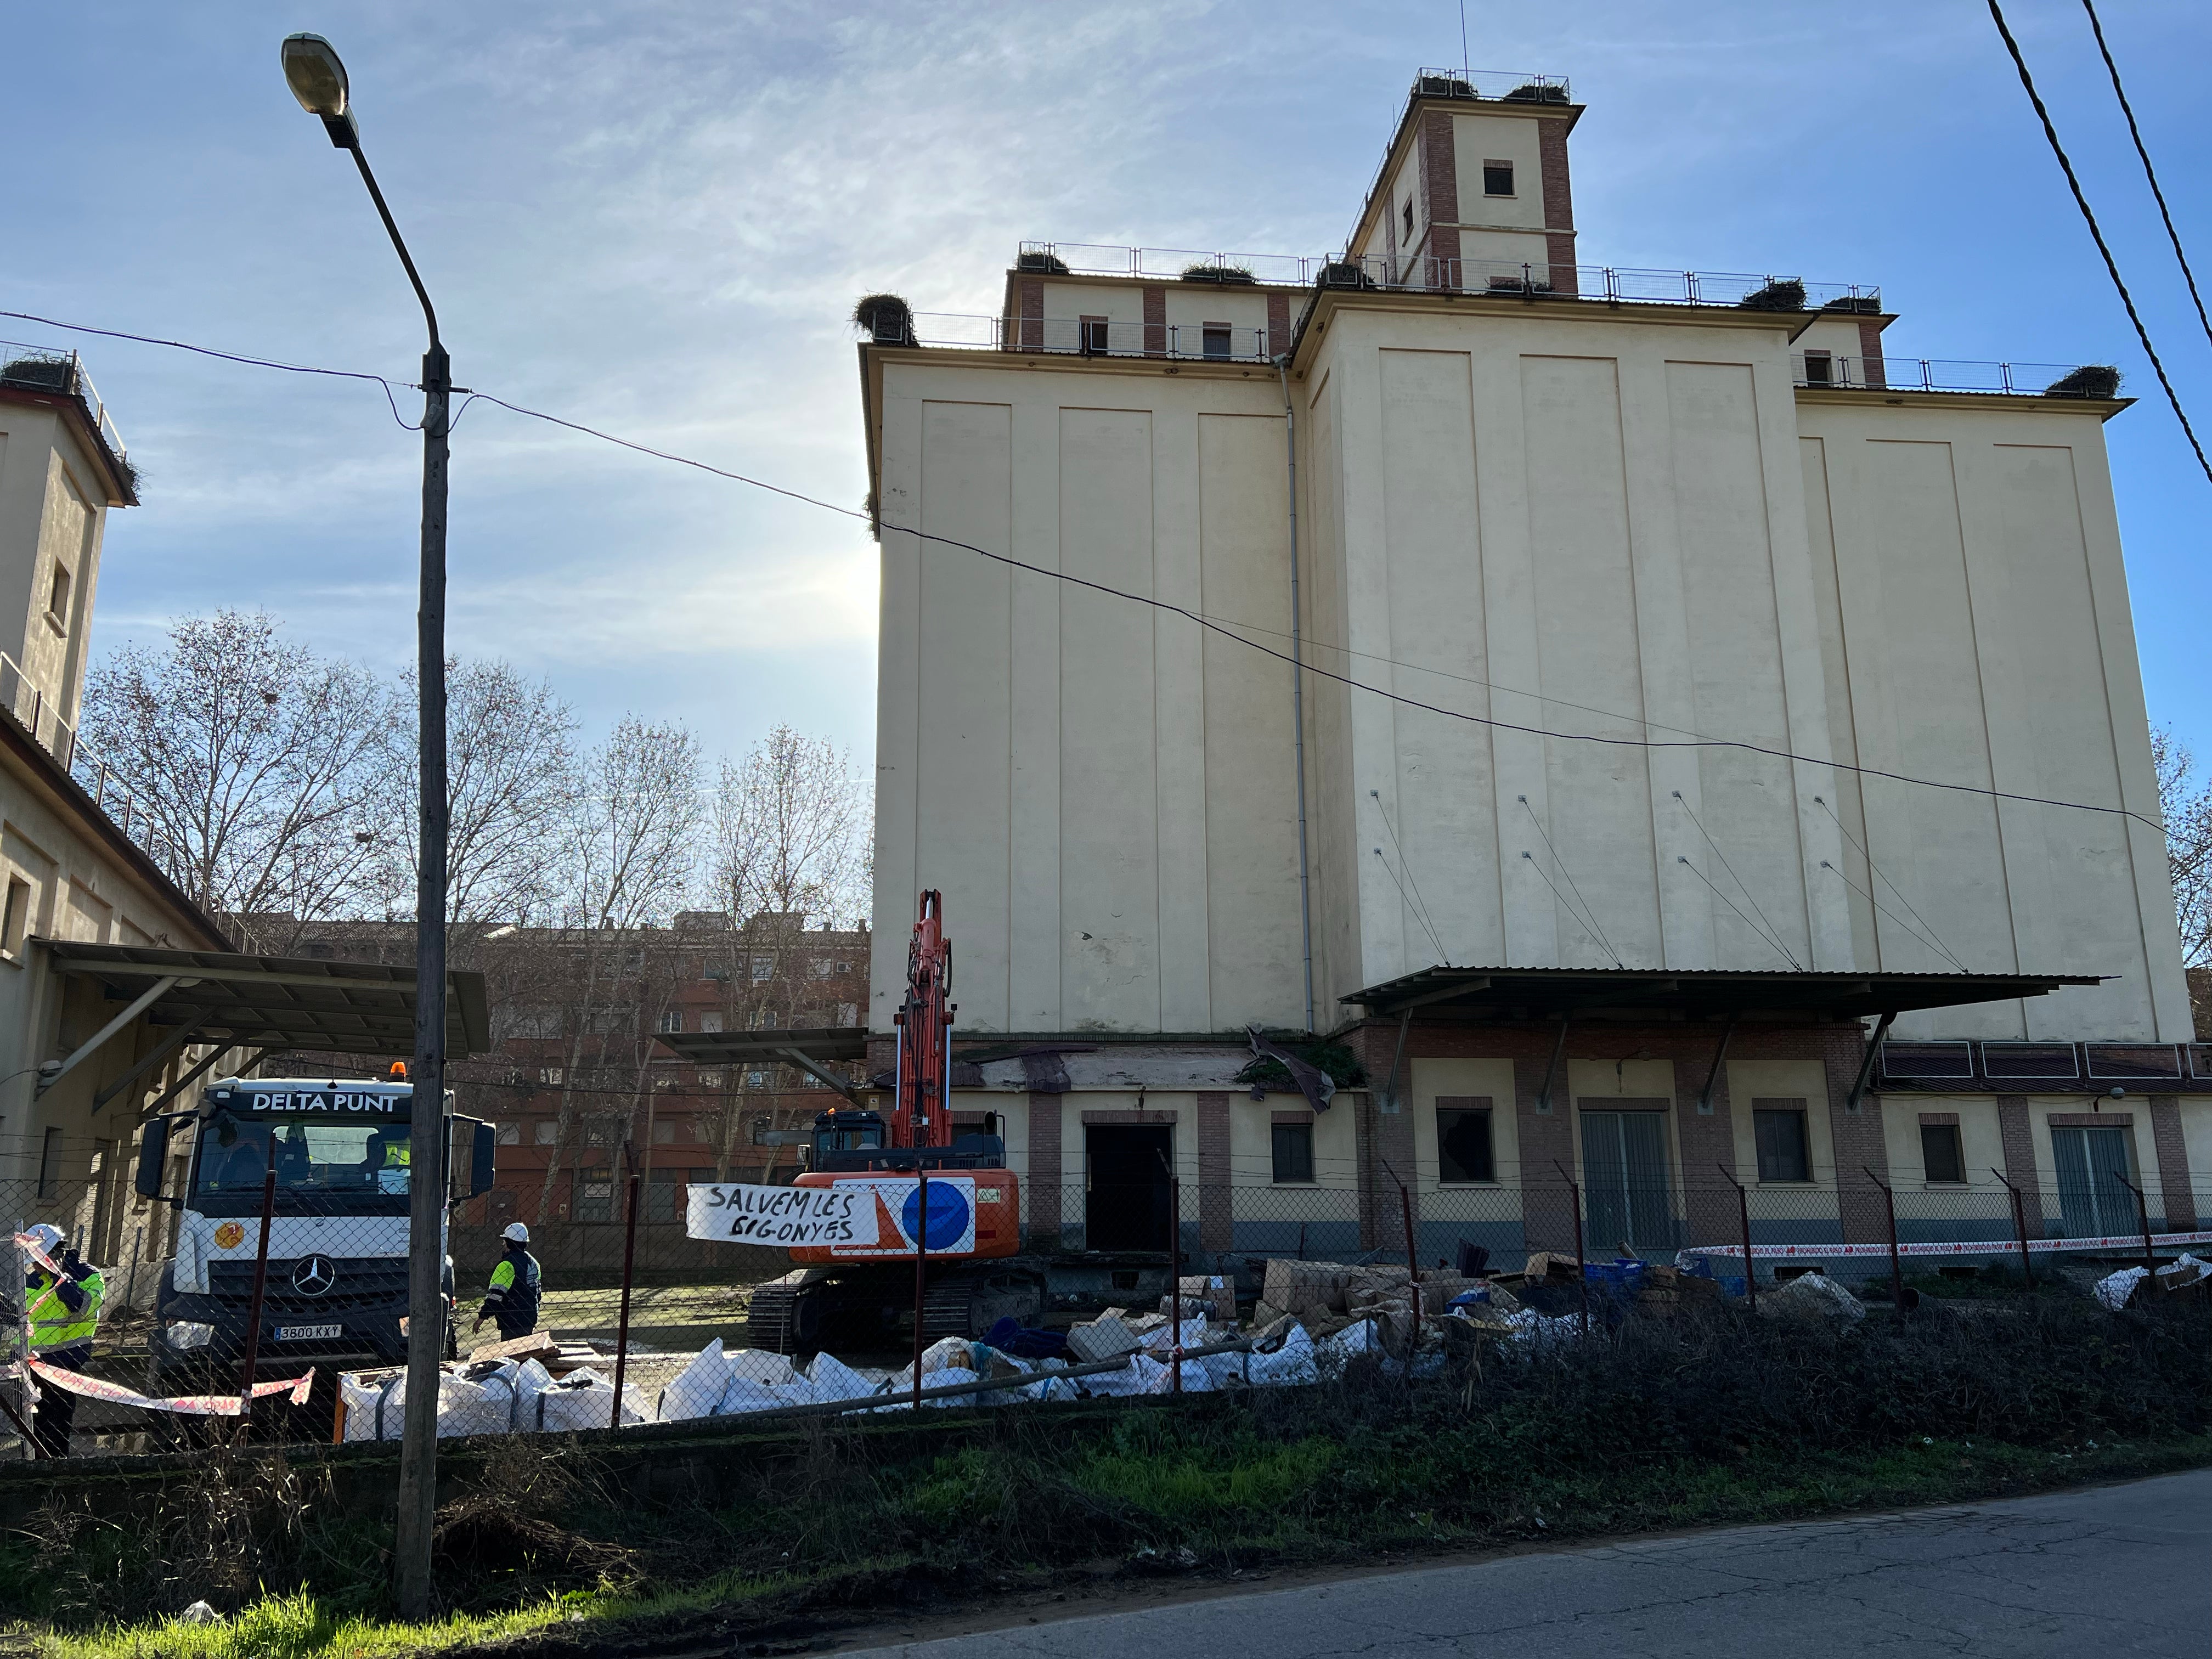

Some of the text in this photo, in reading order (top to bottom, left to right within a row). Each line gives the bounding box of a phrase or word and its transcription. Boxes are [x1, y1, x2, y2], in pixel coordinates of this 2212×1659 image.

[252, 1093, 398, 1112] DELTA PUNT
[708, 1187, 855, 1219] SALVEM LES
[283, 1325, 338, 1338] 3800 KXY
